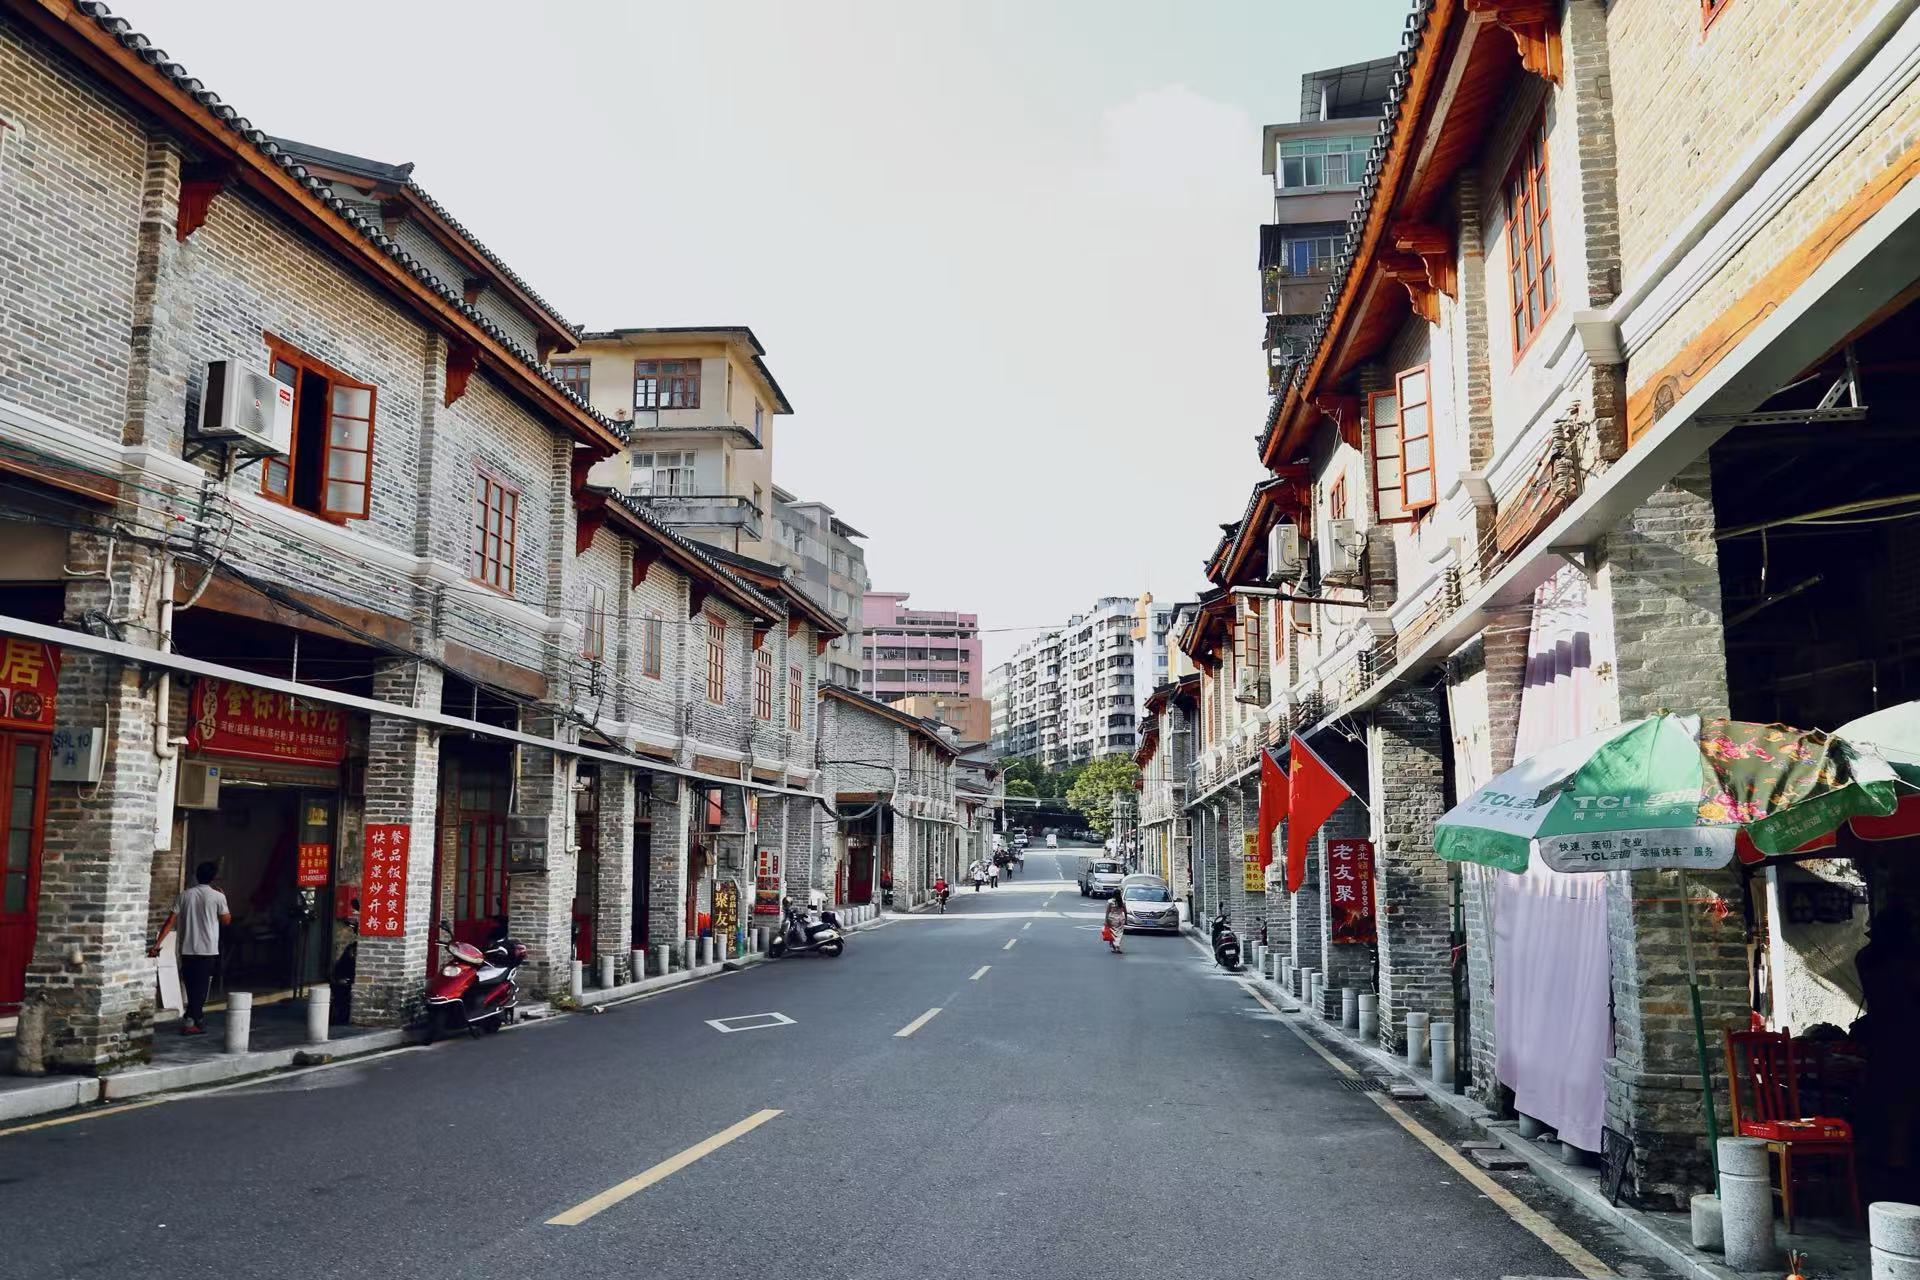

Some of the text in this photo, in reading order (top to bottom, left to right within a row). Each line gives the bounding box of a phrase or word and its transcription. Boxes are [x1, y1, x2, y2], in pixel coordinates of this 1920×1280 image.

[0, 638, 44, 687] 居
[1333, 844, 1355, 901] 老友聚
